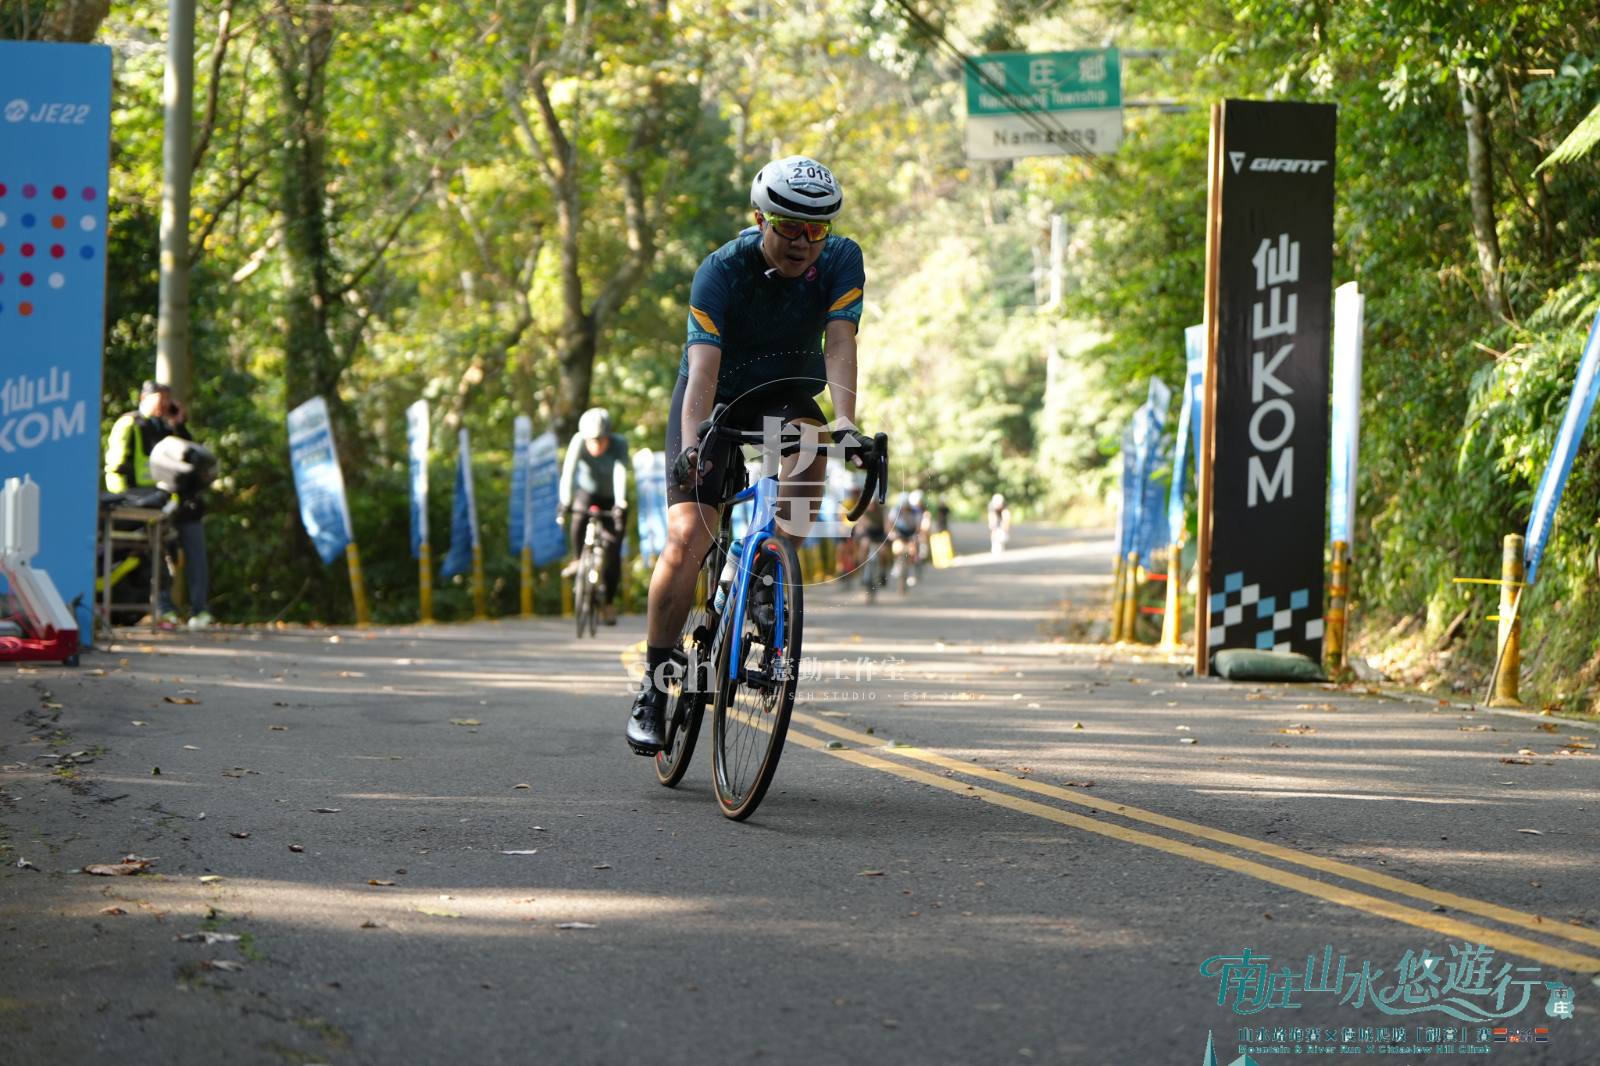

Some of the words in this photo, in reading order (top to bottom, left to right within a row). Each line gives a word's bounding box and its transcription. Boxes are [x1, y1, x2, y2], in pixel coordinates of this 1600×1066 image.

[30, 103, 91, 124] JE22
[793, 166, 832, 184] 2015
[1249, 158, 1328, 174] GIANT
[0, 366, 70, 416] 仙山
